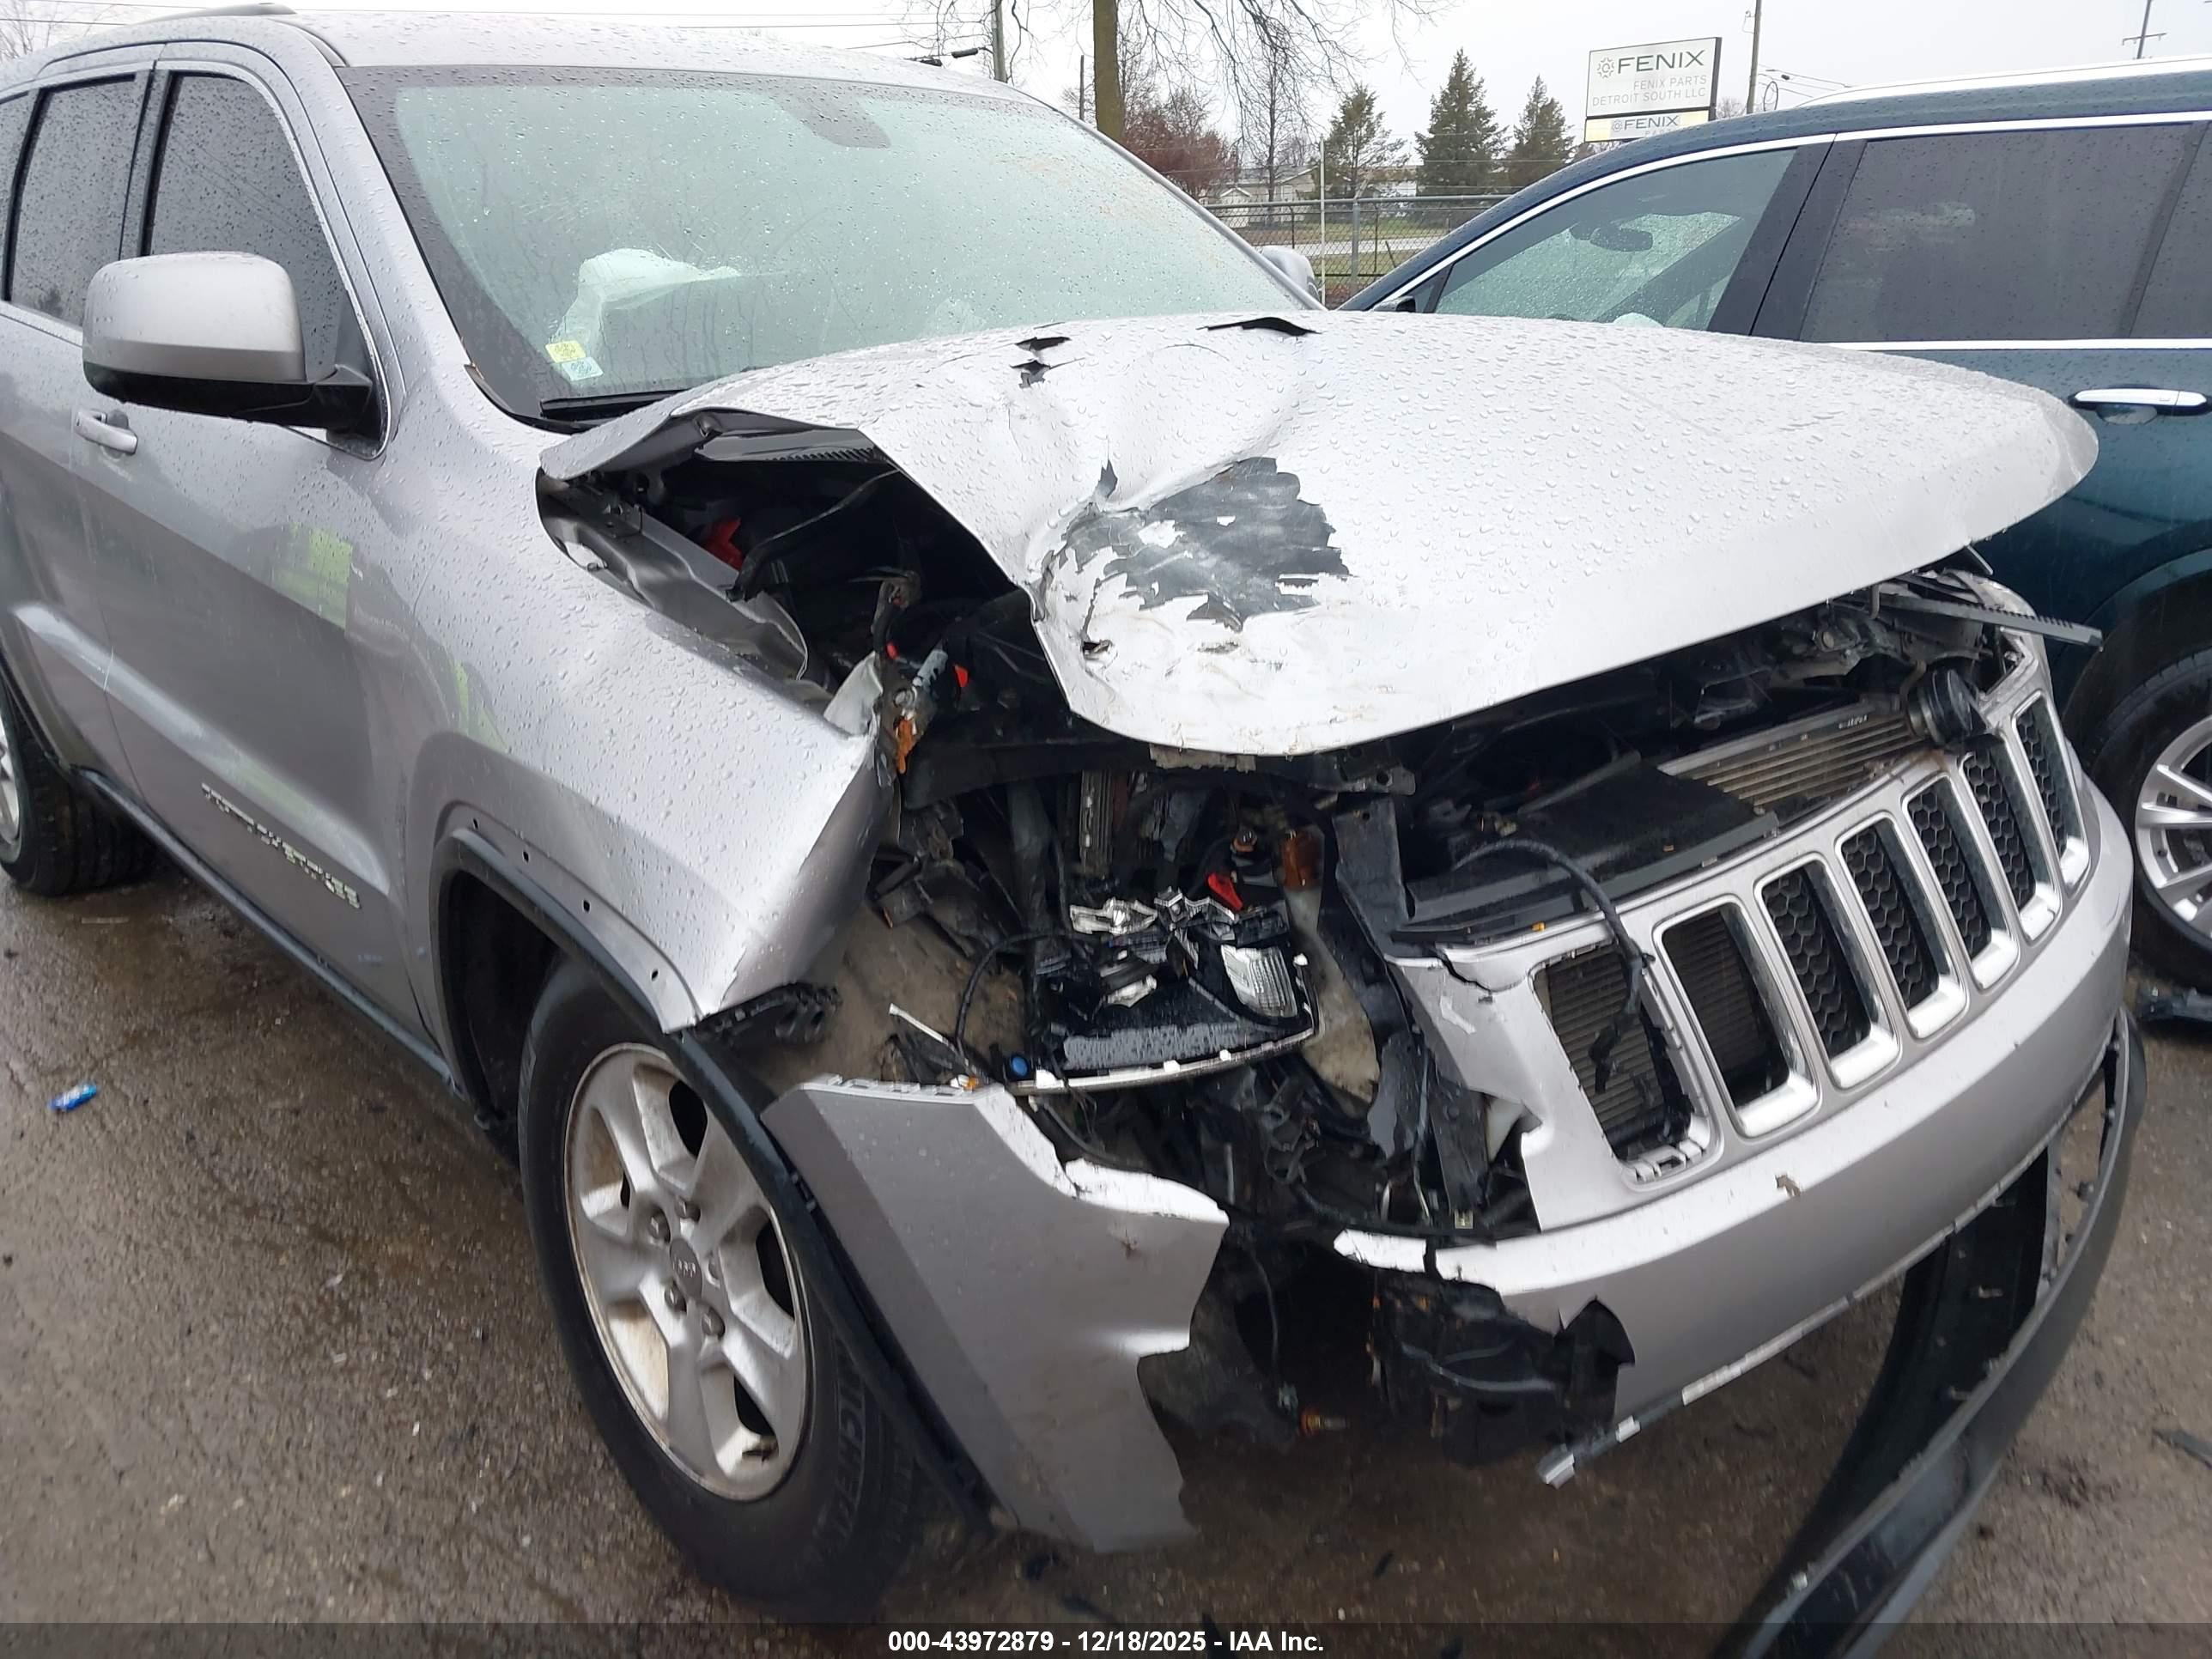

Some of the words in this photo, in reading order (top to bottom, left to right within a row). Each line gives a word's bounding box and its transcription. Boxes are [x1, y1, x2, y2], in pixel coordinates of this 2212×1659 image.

[1618, 50, 1705, 74] FENIX
[1634, 79, 1665, 90] FENIX
[1670, 75, 1707, 87] PARTS
[1593, 94, 1639, 107] DETROIT
[1643, 91, 1681, 102] SOUTH
[1686, 88, 1706, 98] LLC
[1624, 115, 1680, 131] FENIX
